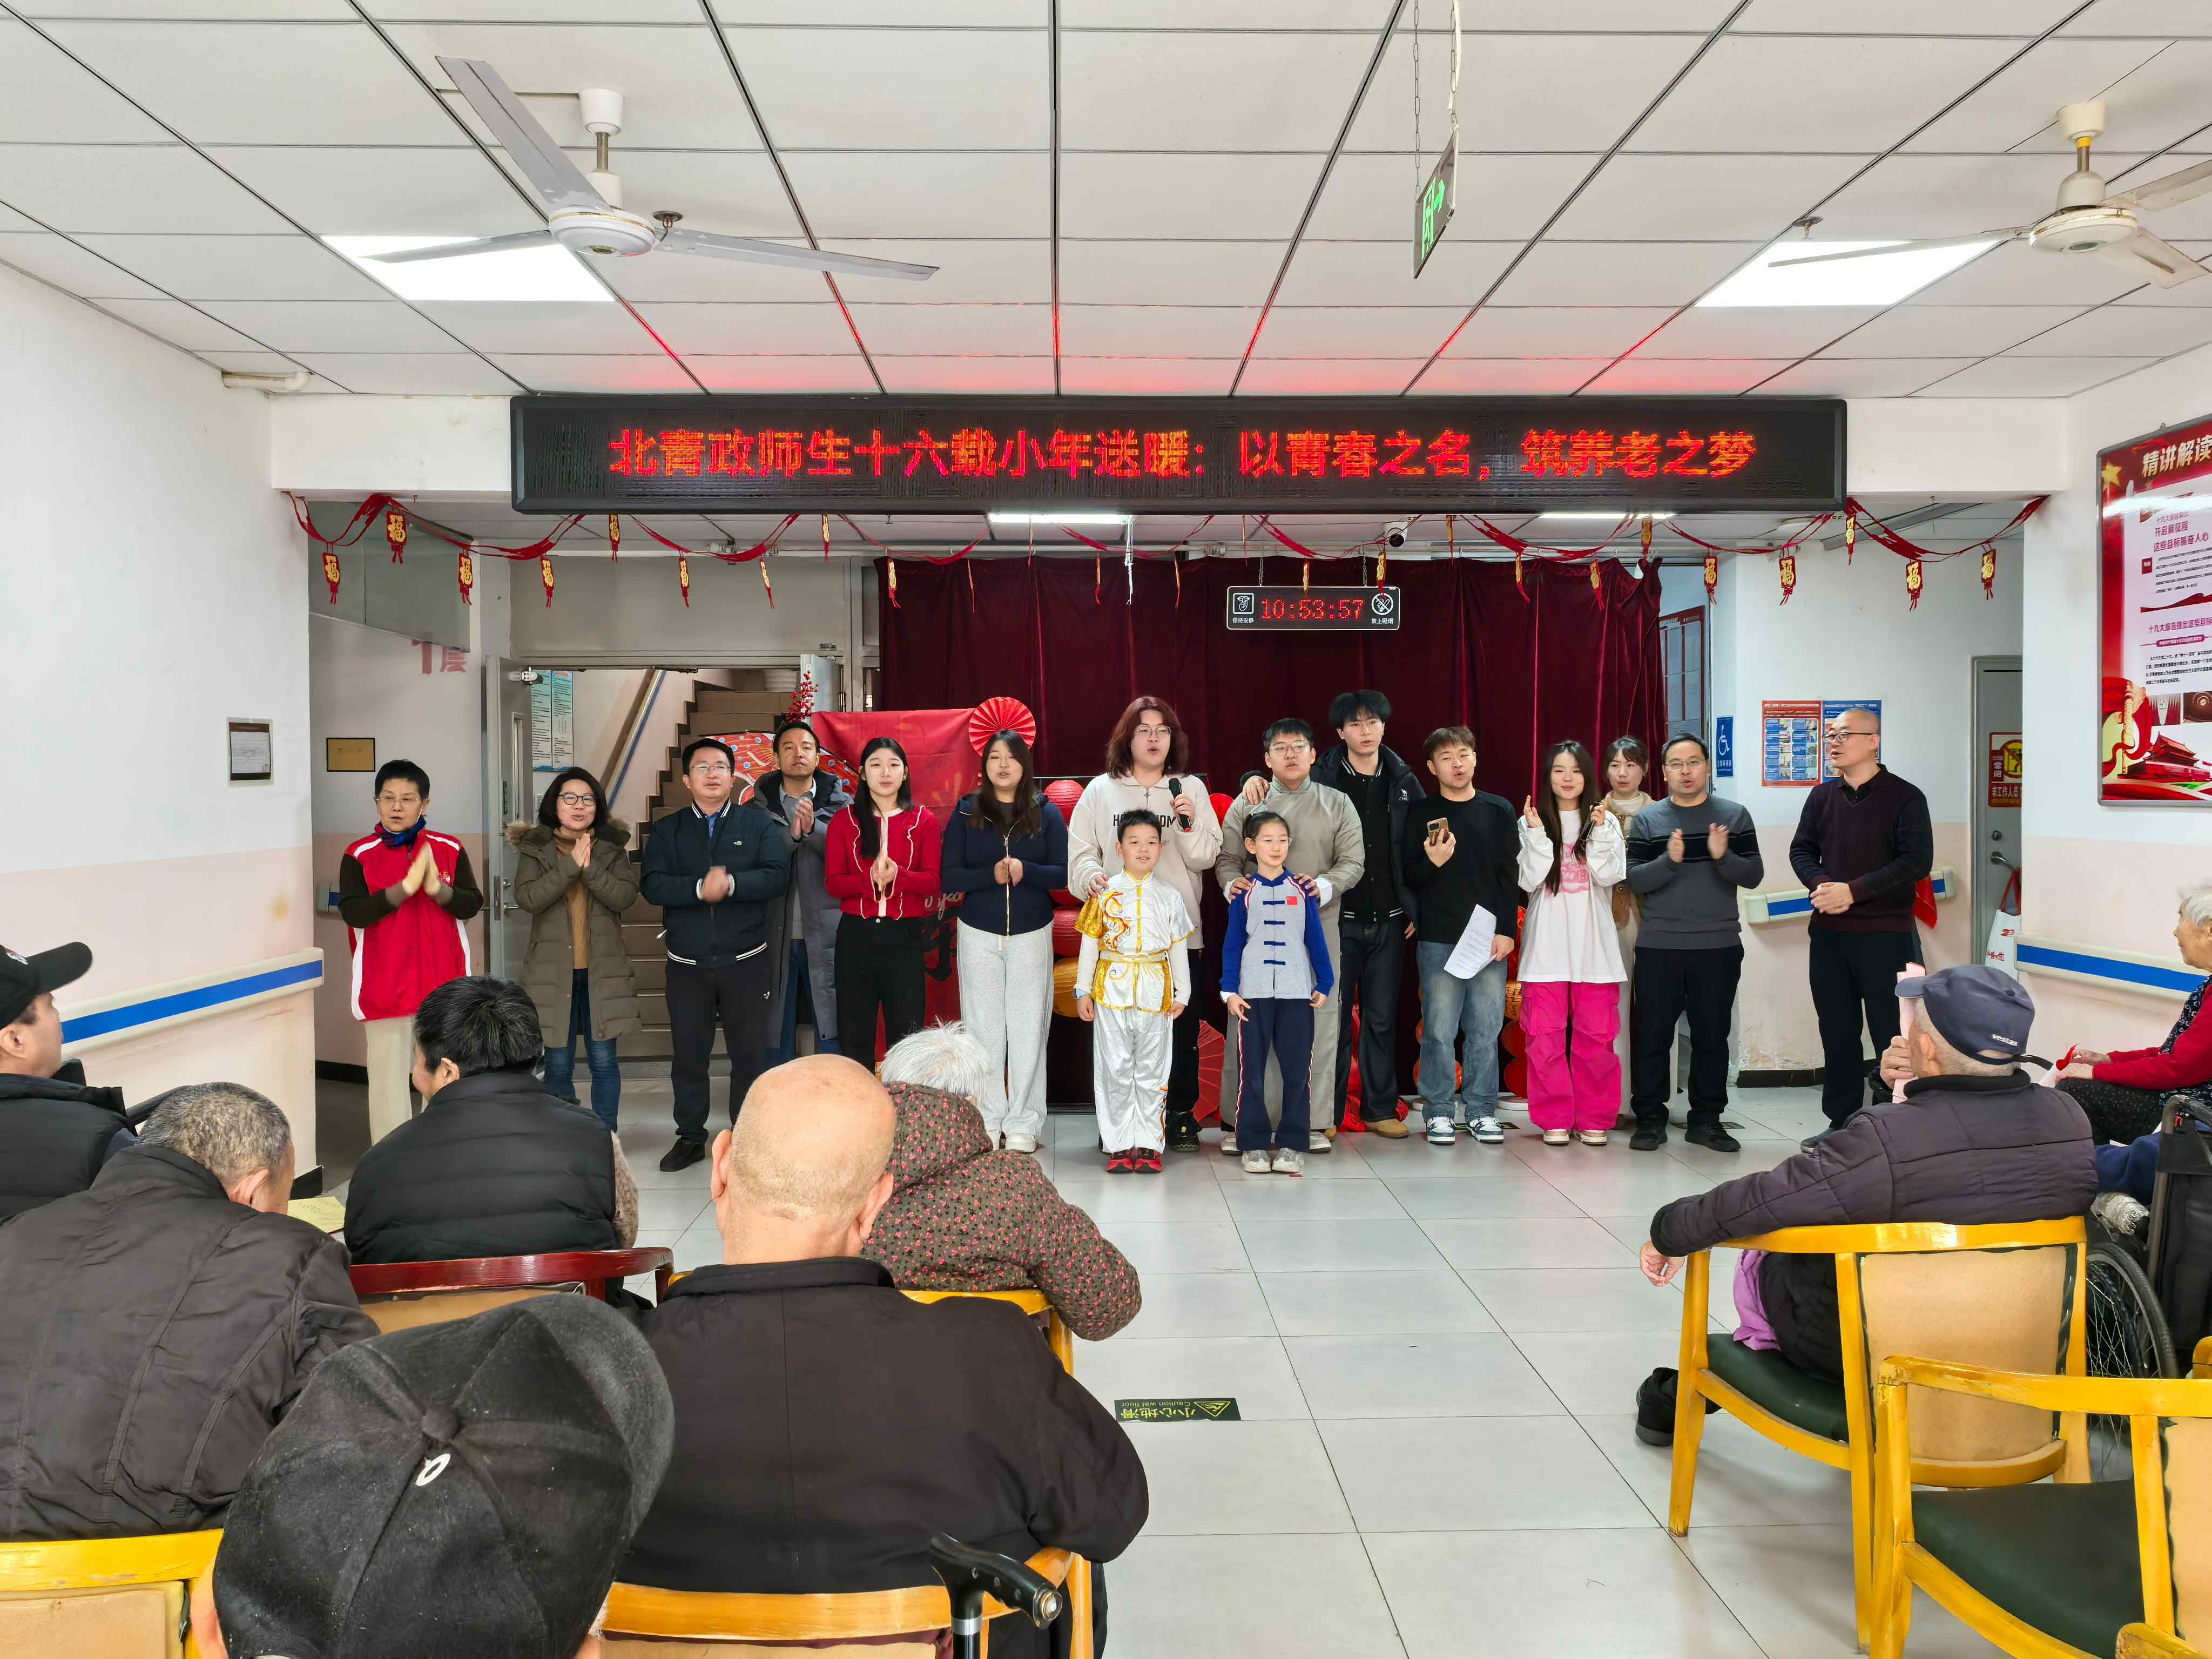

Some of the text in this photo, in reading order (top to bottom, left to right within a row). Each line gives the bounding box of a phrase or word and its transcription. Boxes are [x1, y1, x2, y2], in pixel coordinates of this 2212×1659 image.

[1261, 598, 1365, 620] 10:53:57
[1121, 1407, 1196, 1419] 小心地滑
